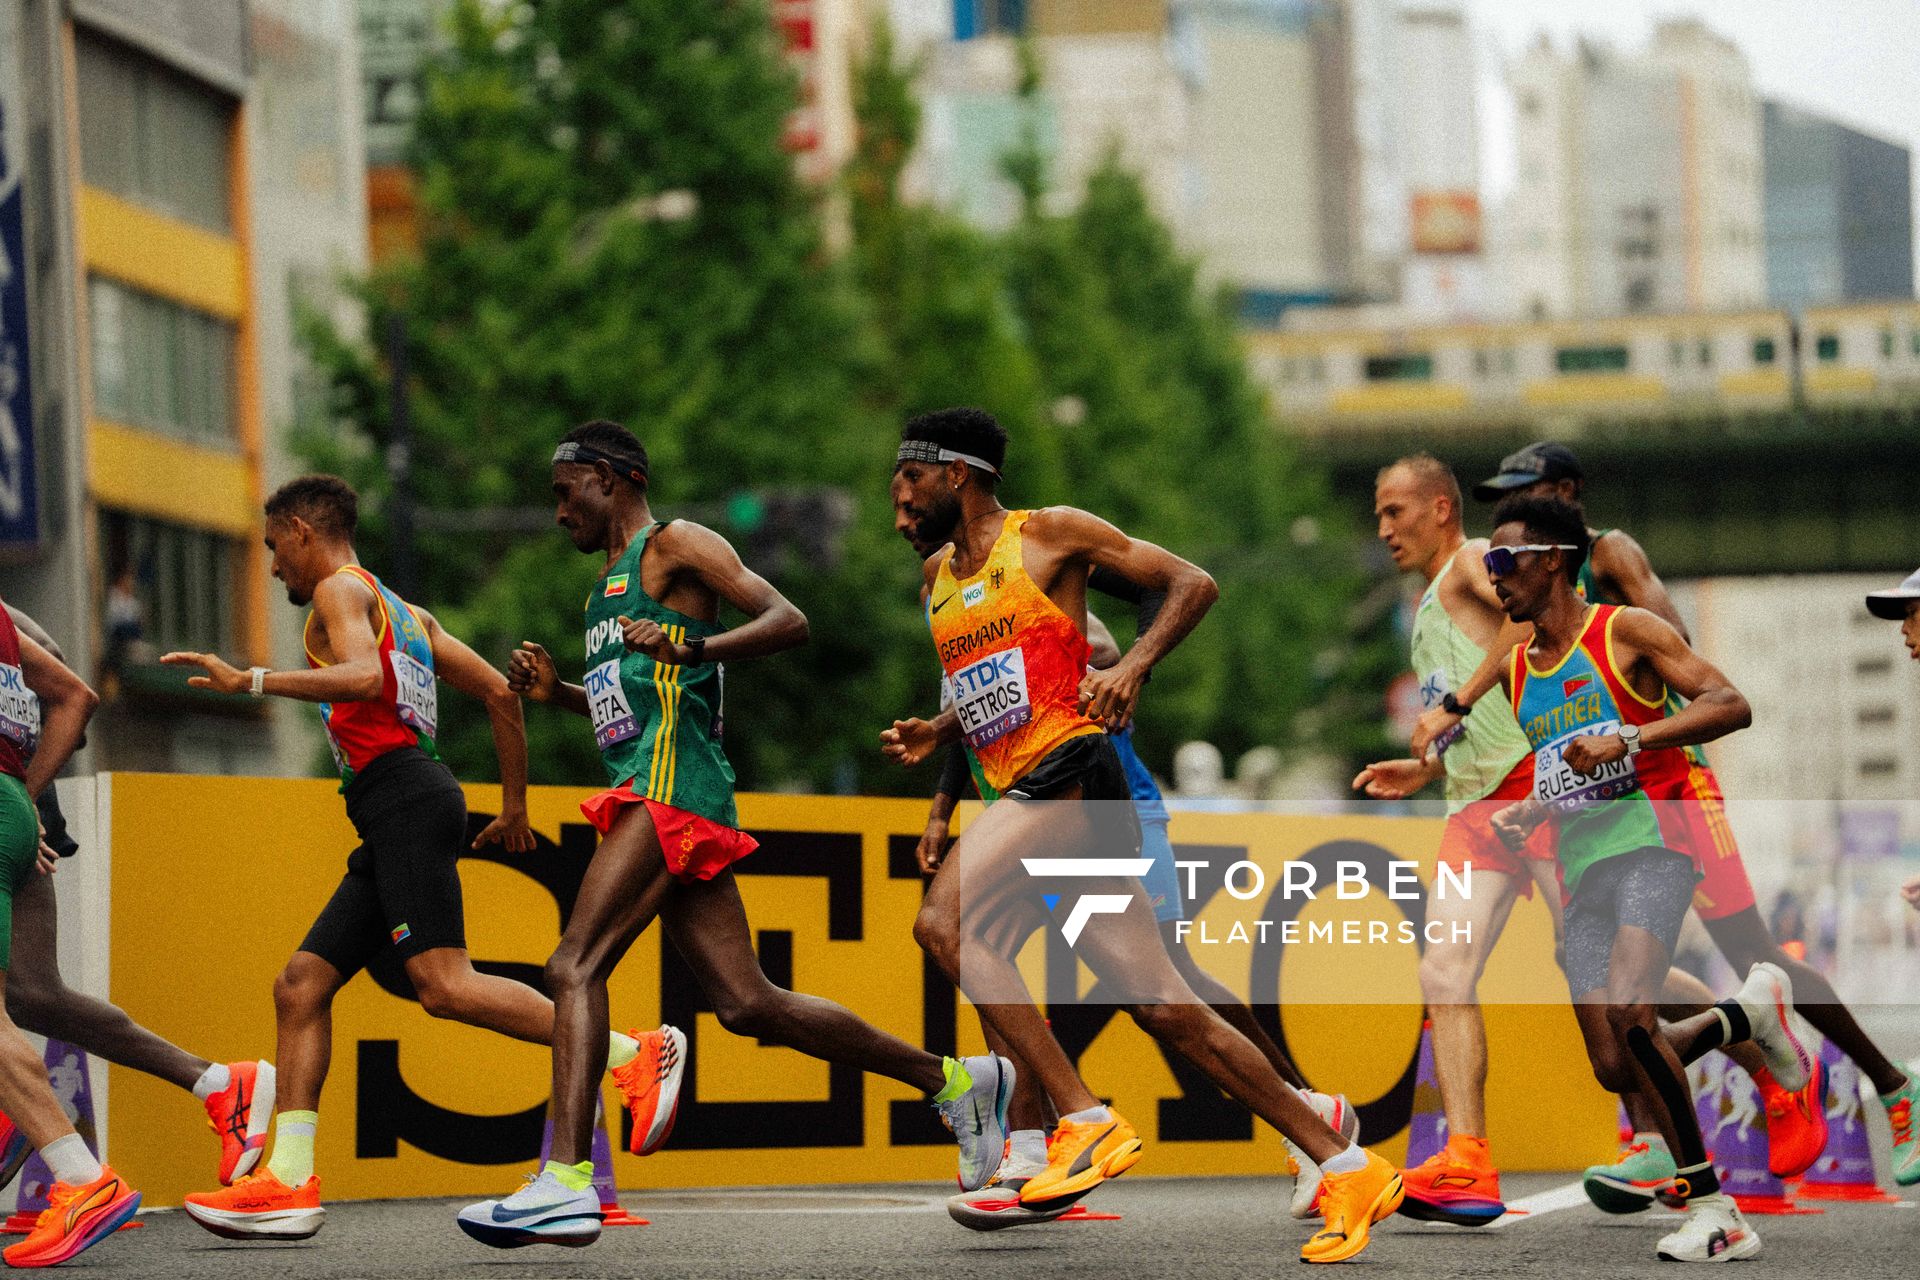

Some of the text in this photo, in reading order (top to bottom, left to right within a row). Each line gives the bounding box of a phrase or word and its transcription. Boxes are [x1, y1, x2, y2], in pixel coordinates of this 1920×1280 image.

[963, 587, 984, 602] WGV
[585, 617, 624, 661] IOPIA
[941, 614, 1016, 663] GERMANY
[0, 666, 22, 692] DK
[585, 664, 614, 698] TDK
[959, 652, 1016, 693] TDK
[958, 681, 1022, 730] PETROS
[1525, 692, 1601, 747] ERITREA
